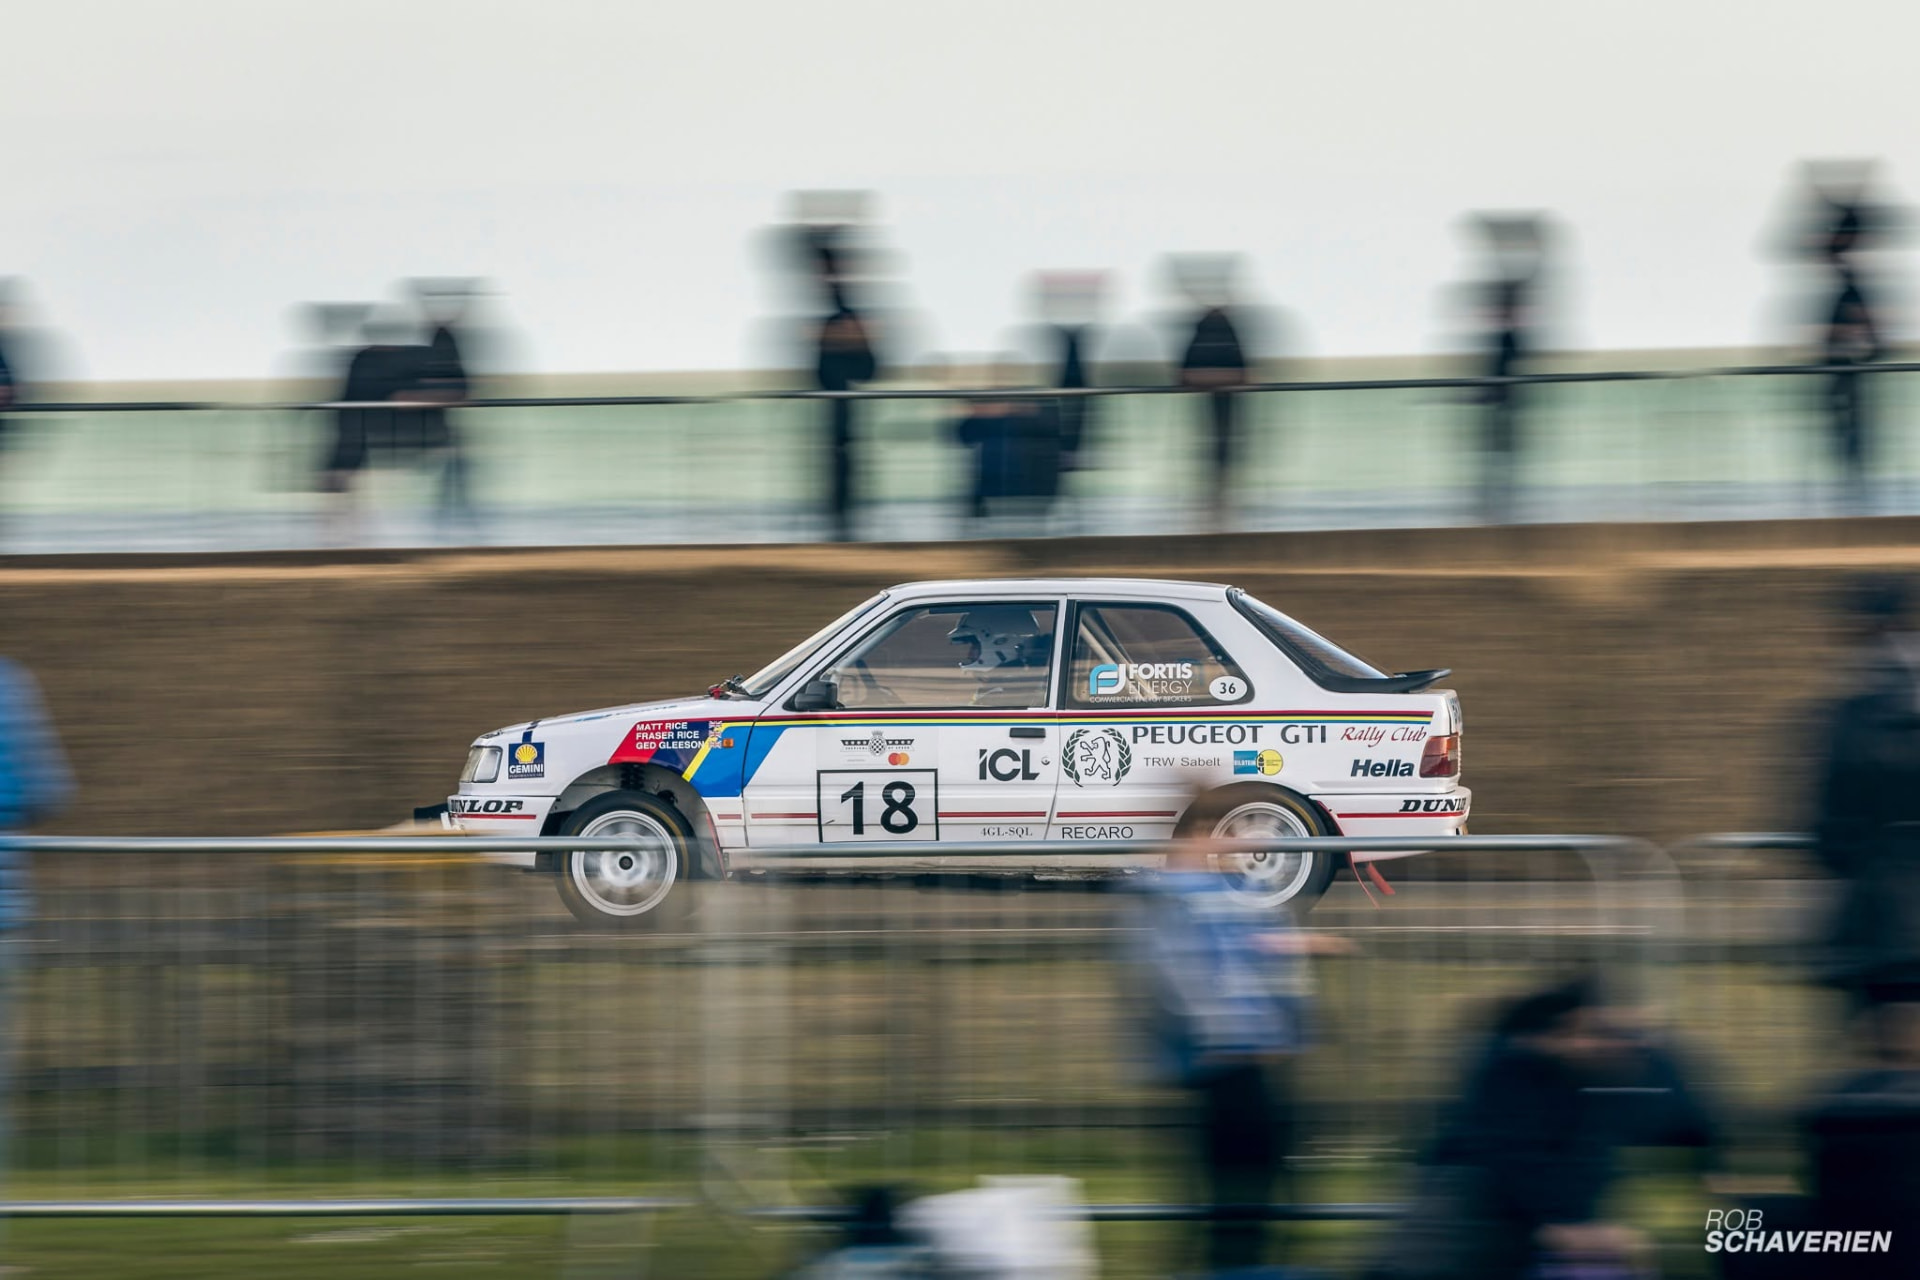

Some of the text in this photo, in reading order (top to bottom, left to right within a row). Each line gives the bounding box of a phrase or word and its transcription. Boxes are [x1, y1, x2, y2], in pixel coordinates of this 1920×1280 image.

[1129, 663, 1192, 679] FORTIS
[1129, 681, 1192, 694] ENERGY
[1219, 682, 1236, 694] 36
[636, 722, 688, 731] MATT RICE
[636, 731, 700, 740] FRASER RICE
[1132, 725, 1326, 744] PEUGEOT GTI
[1340, 726, 1427, 747] Rally Club
[635, 740, 706, 749] GED GLEESON
[1143, 757, 1221, 767] TRW Sabelt
[1350, 759, 1414, 777] Hella
[509, 764, 544, 774] GEMINI
[841, 780, 918, 835] 18
[1061, 826, 1134, 840] RECARO
